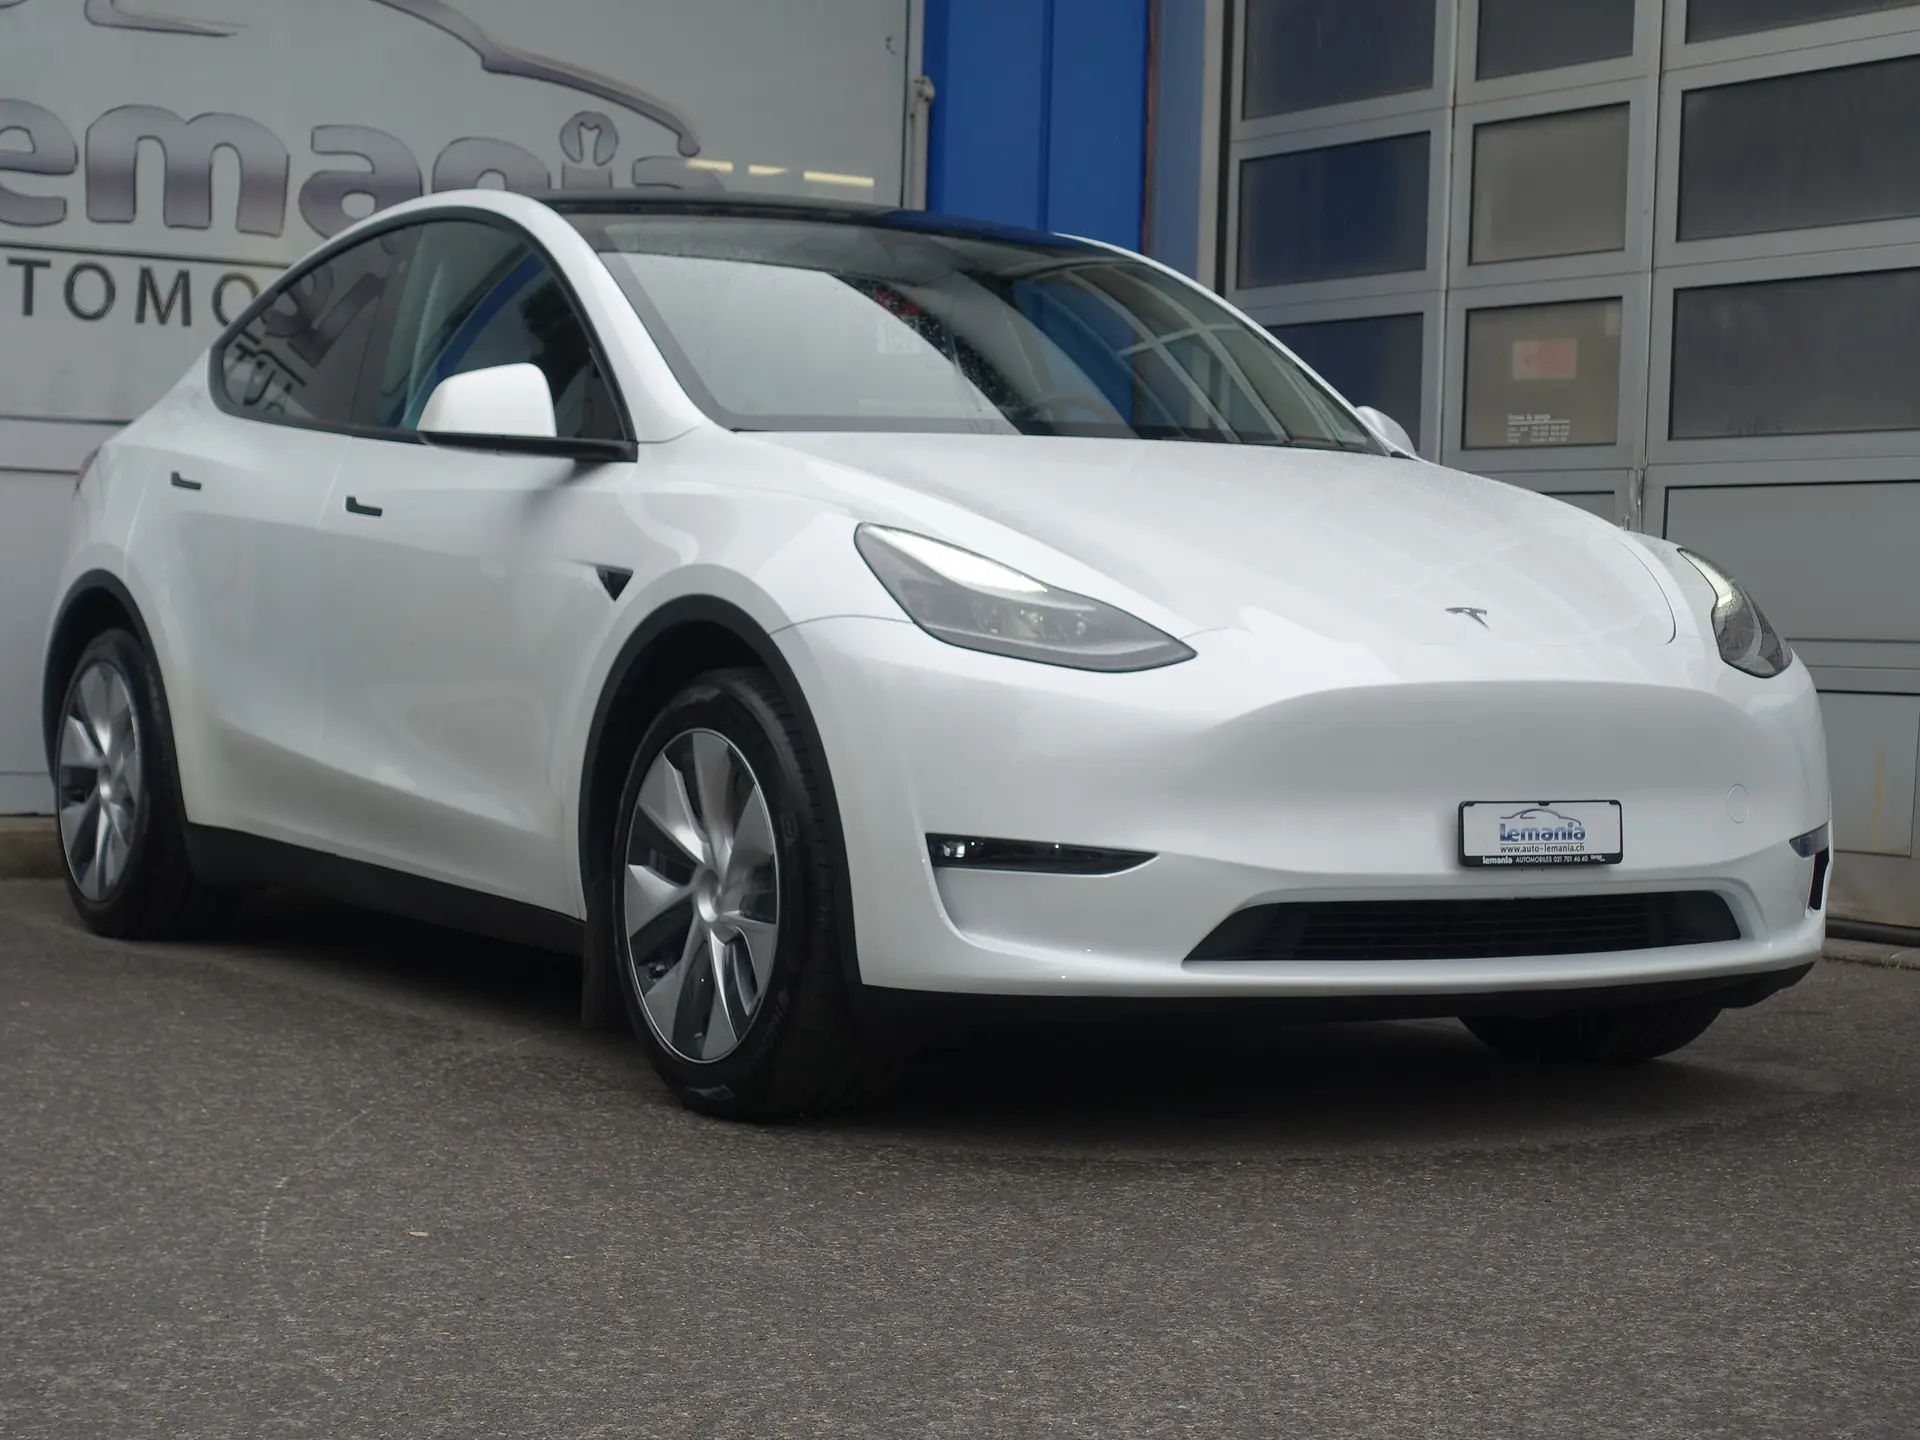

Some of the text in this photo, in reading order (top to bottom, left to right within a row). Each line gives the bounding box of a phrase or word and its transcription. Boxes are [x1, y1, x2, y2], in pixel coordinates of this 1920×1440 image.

[1500, 823, 1586, 842] Lemania
[1500, 844, 1585, 853] www.auto-lemania.ch
[1515, 856, 1552, 864] AUTOMOBILES
[1553, 855, 1562, 863] 021
